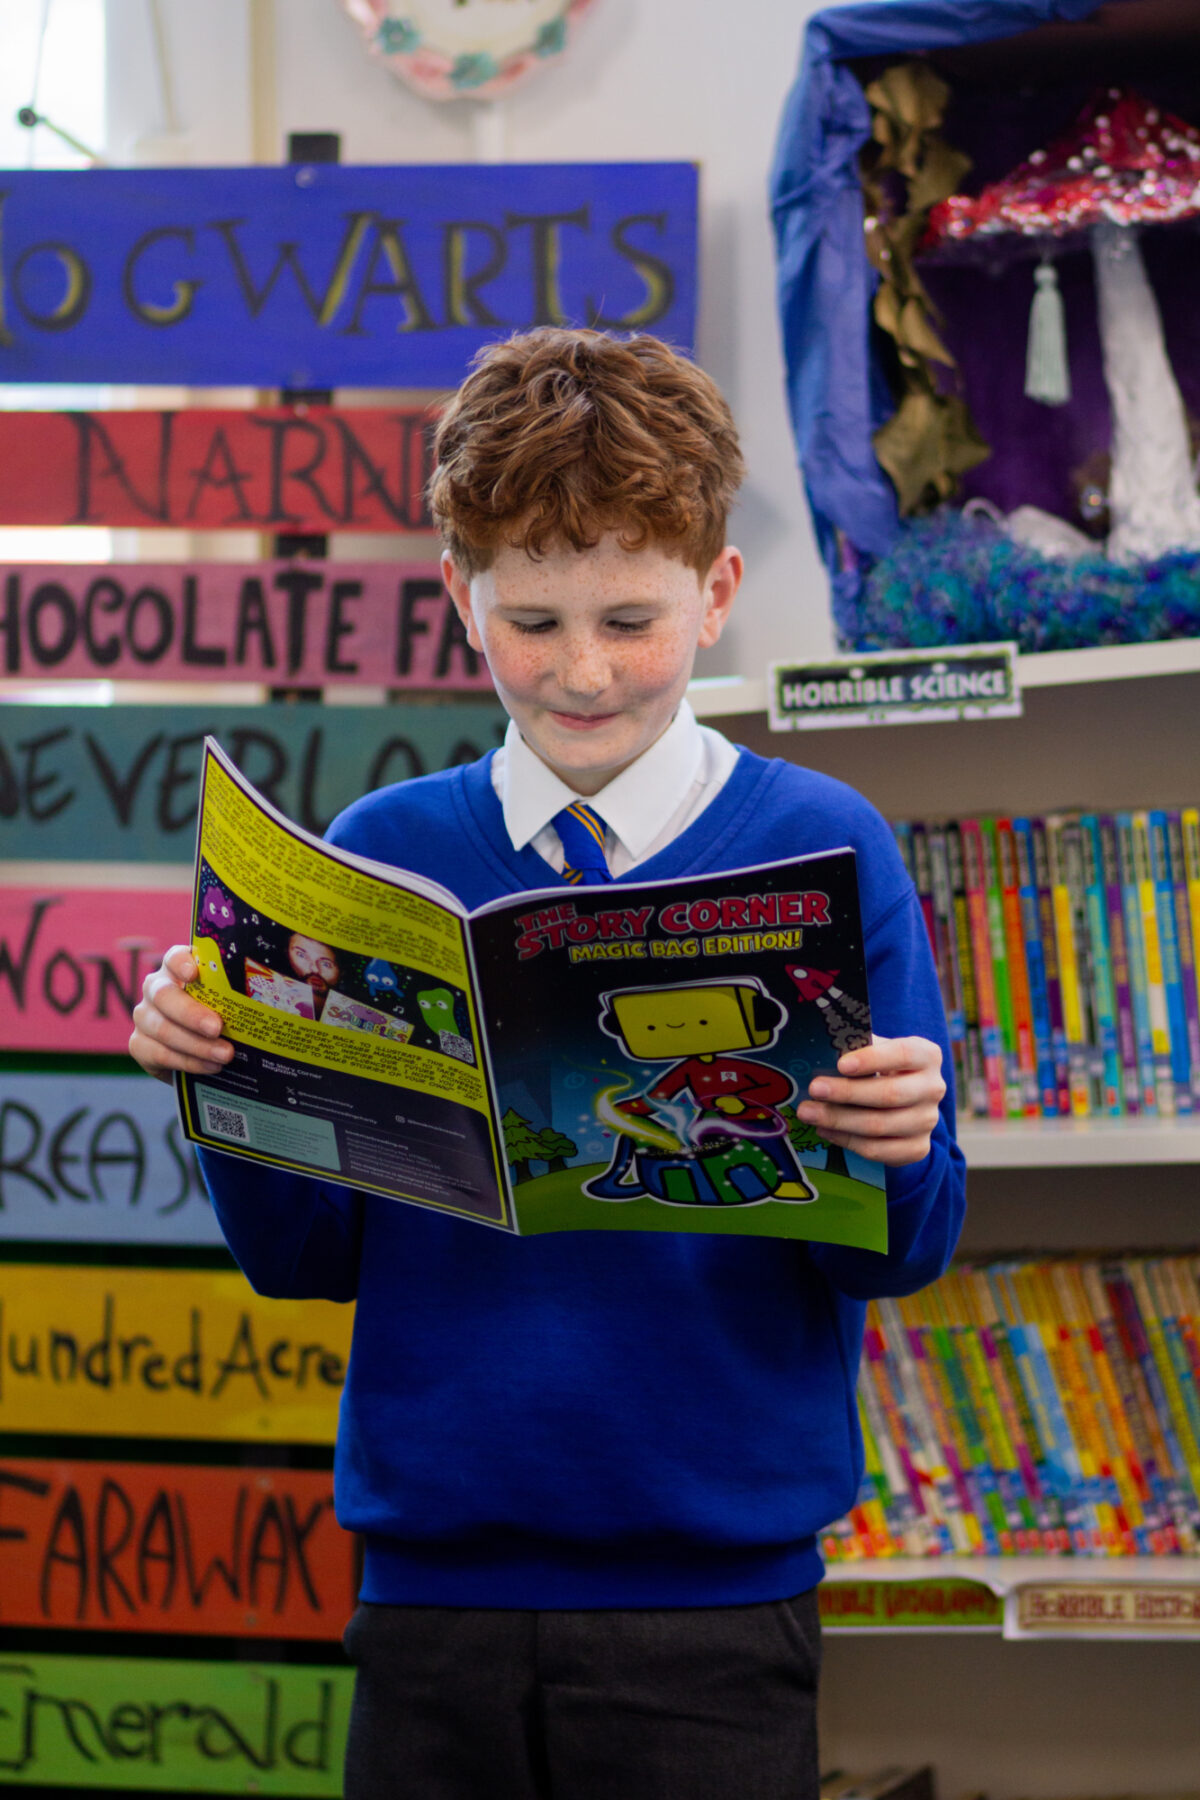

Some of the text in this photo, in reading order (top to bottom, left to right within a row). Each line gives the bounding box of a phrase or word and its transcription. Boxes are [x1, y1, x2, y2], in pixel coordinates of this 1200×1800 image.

[0, 188, 675, 346] OGWARTS
[782, 662, 1006, 707] HORRIBLE SCIENCE
[514, 902, 578, 932] THE
[515, 905, 655, 960] STORY
[659, 890, 832, 935] CORNER
[569, 929, 804, 963] MAGIC BAG EDITION!
[0, 1293, 203, 1396] undred
